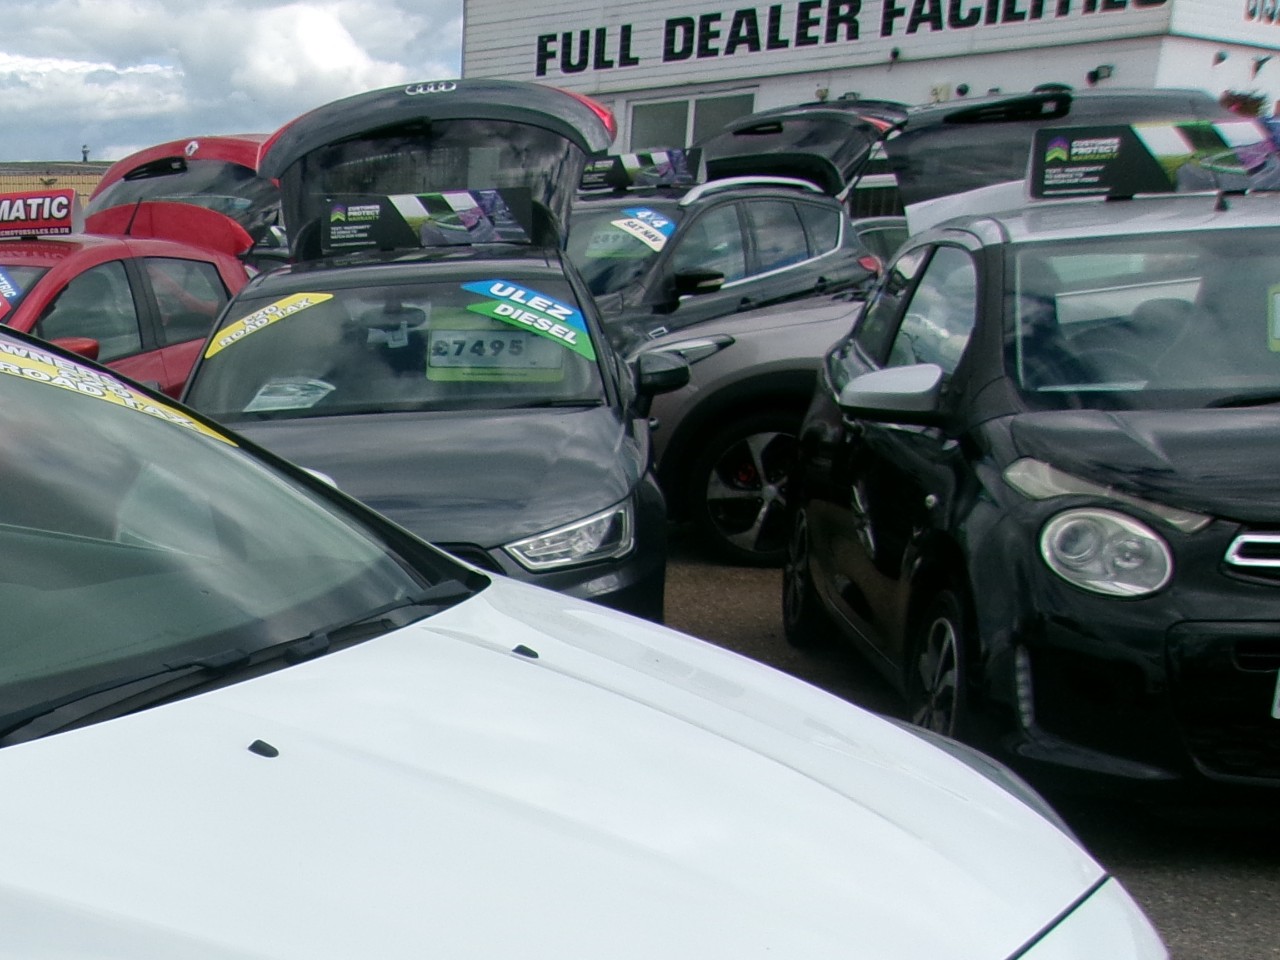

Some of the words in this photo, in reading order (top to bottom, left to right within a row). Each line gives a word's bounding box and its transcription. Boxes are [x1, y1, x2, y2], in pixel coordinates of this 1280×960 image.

[536, 24, 640, 77] FULL
[662, 0, 862, 63] DEALER
[624, 220, 644, 232] SAT
[643, 229, 663, 243] NAV
[489, 282, 573, 321] ULEZ
[219, 317, 270, 347] ROAD
[275, 298, 312, 318] TAX
[493, 303, 578, 345] DIESEL
[432, 339, 524, 357] £7495
